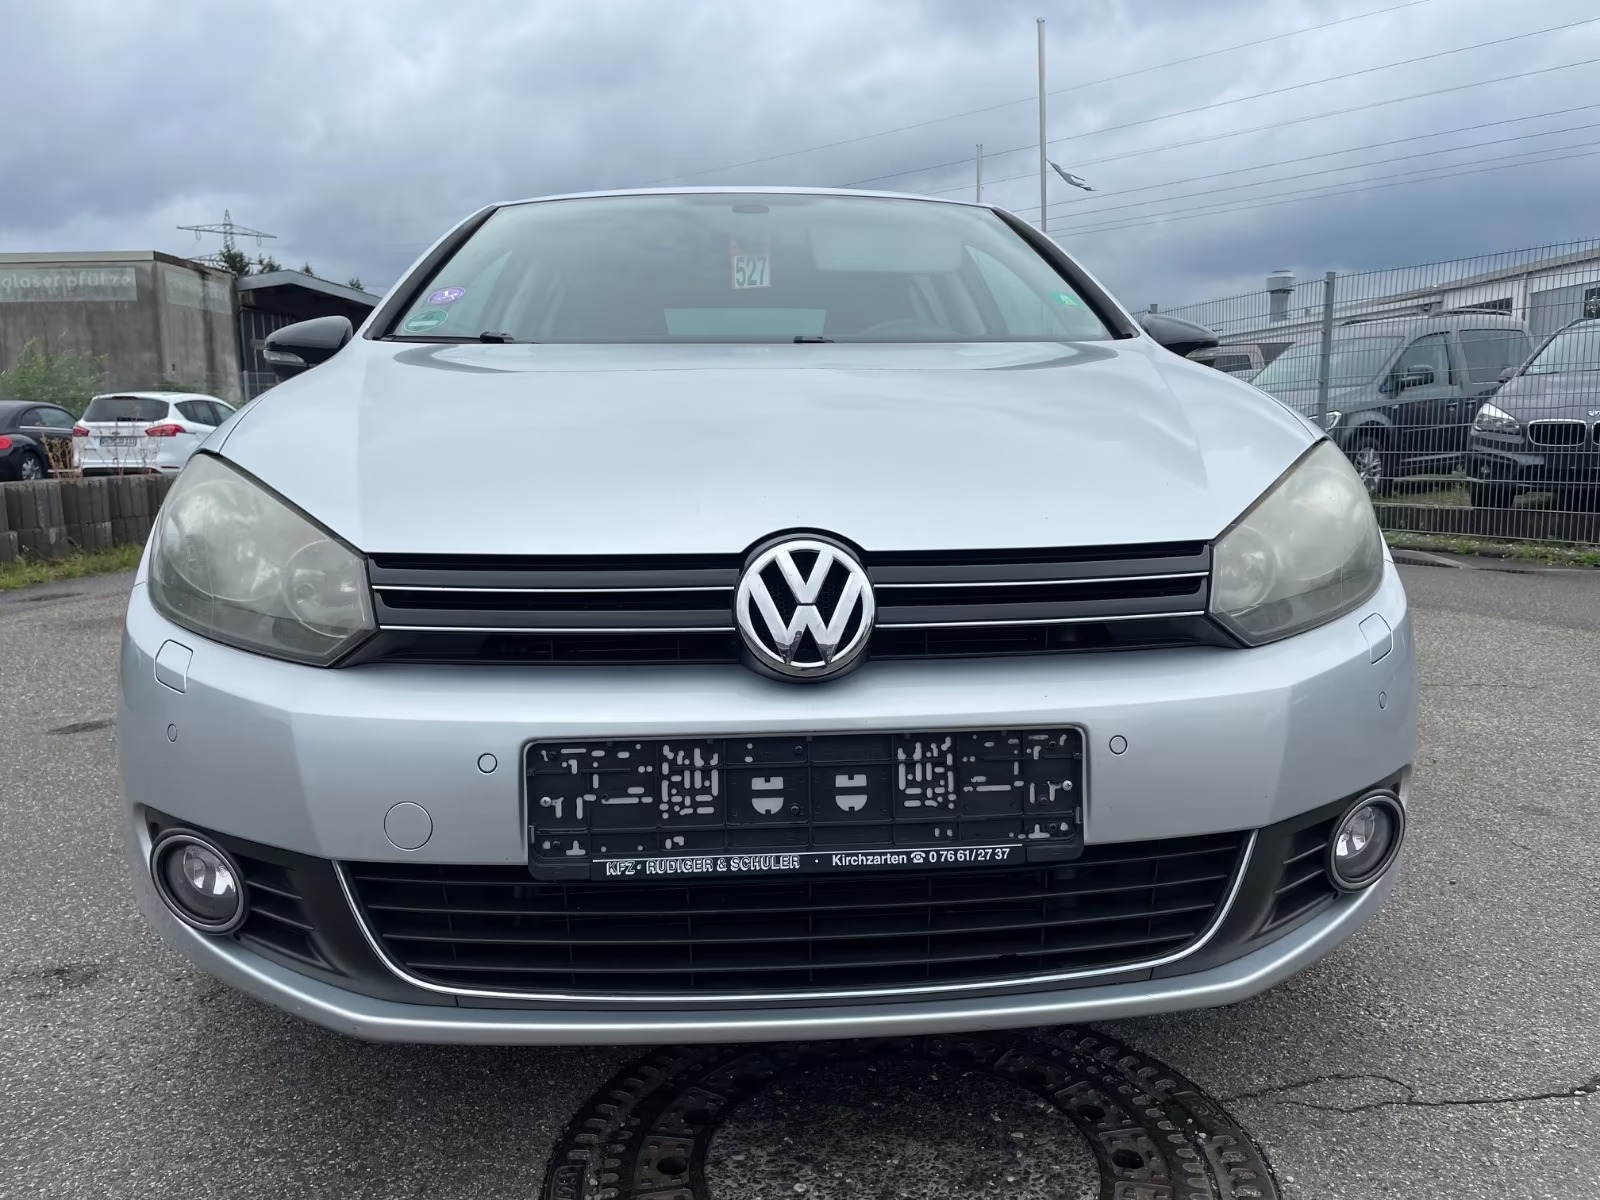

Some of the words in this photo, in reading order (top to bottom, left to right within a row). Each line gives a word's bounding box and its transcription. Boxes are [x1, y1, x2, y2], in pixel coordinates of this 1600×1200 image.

[735, 256, 768, 287] 527
[737, 540, 875, 677] VW
[716, 858, 728, 872] &
[832, 852, 907, 866] Kirchzarten
